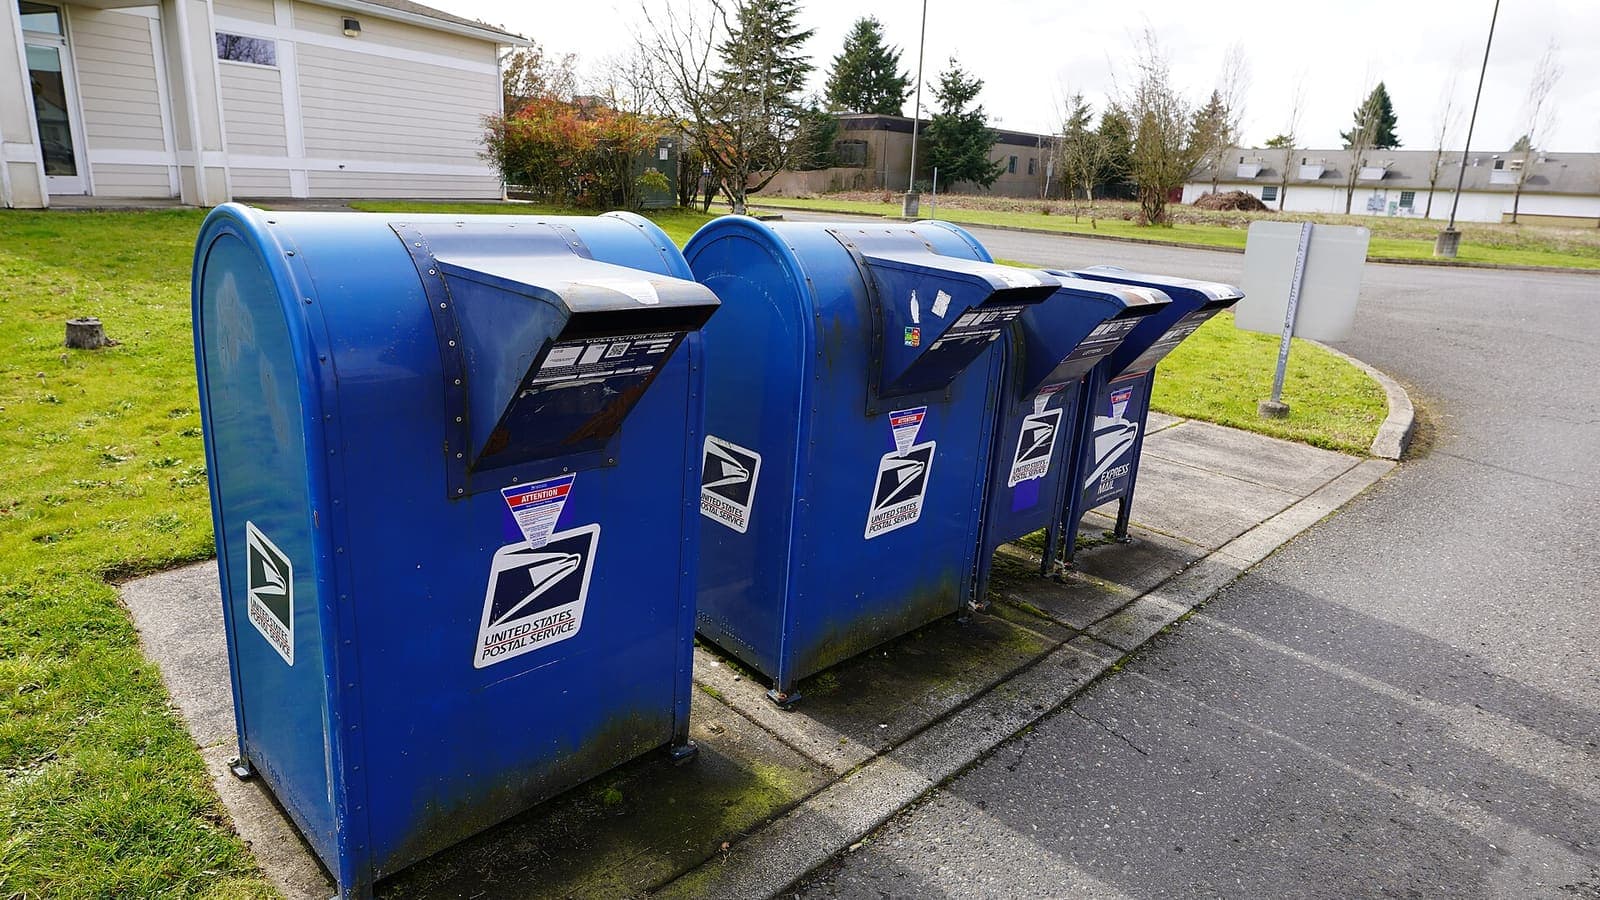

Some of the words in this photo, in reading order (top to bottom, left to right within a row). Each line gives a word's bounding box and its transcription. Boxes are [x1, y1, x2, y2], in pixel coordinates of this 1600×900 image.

[1101, 463, 1129, 482] EXPRESS
[521, 489, 558, 503] ATTENTION
[1097, 480, 1115, 495] MAIL
[701, 502, 719, 516] OSTAL
[719, 509, 744, 528] SERVICE
[721, 501, 743, 517] STATES
[870, 509, 895, 523] UNITED
[895, 502, 917, 515] STATES
[869, 518, 893, 533] POSTAL
[893, 510, 918, 525] SERVICE
[251, 596, 269, 624] UNITED
[269, 617, 288, 643] STATES
[484, 623, 530, 646] UNITED
[532, 609, 572, 629] STATES
[251, 610, 269, 634] POSTAL
[269, 627, 291, 658] SERVICE
[482, 637, 527, 660] POSTAL
[529, 620, 575, 644] SERVICE
